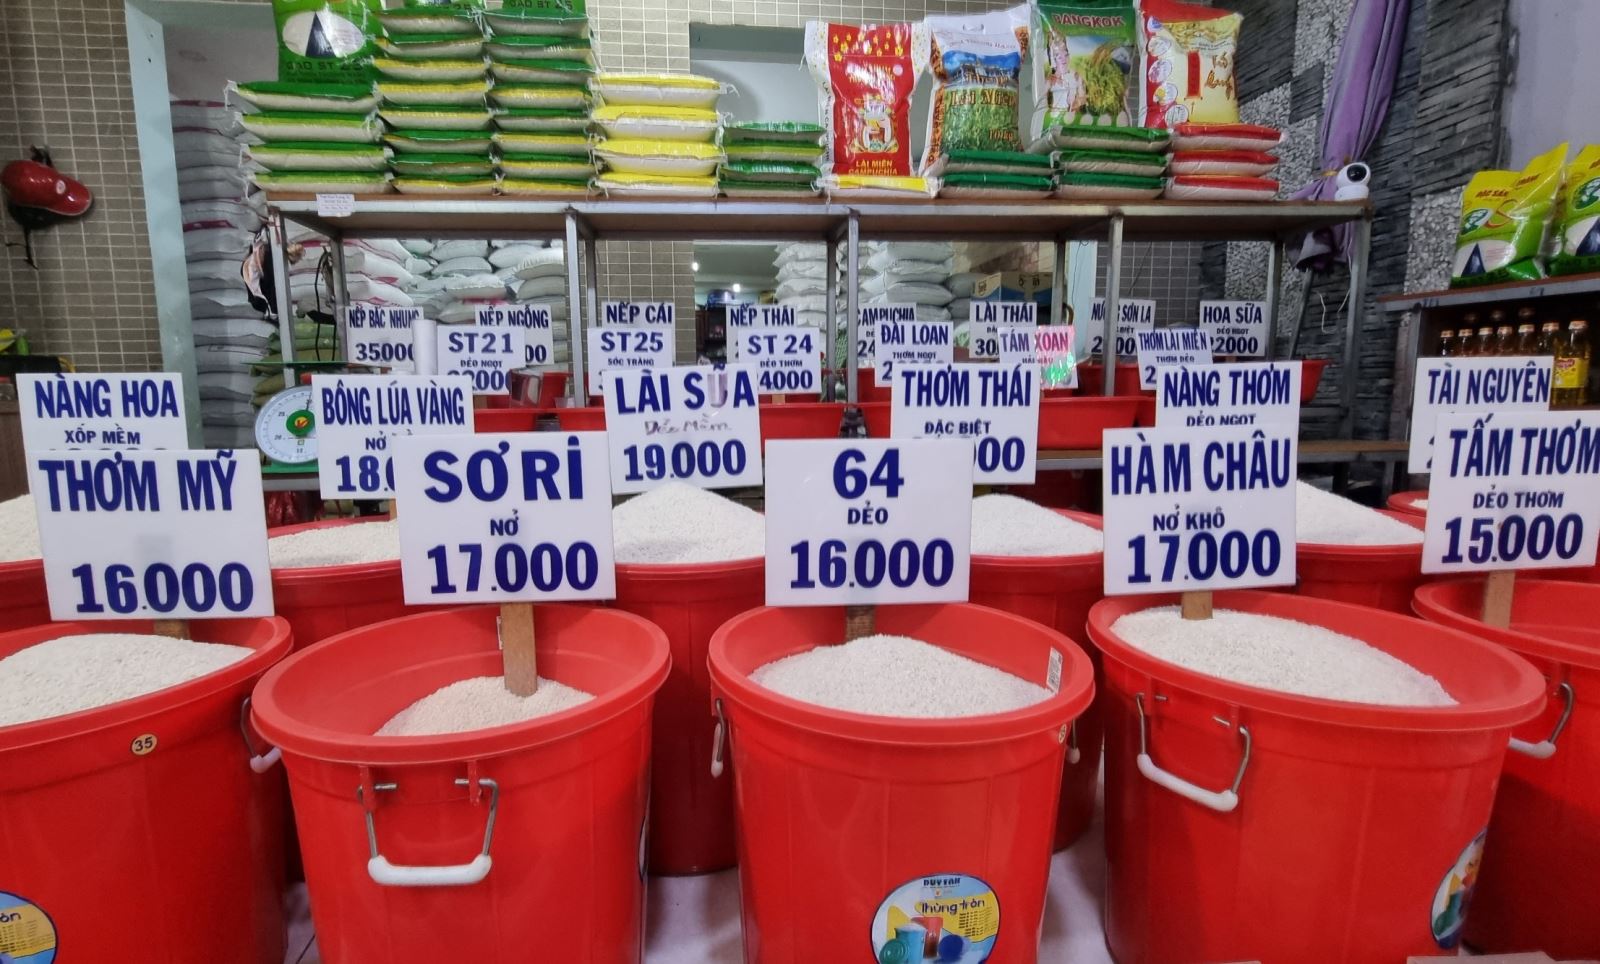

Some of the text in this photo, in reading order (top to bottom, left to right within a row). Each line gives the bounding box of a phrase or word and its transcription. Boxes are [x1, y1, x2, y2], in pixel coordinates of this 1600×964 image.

[606, 301, 672, 325] NẾP CÁI
[730, 303, 757, 326] NẾP
[881, 321, 905, 345] ĐÀI
[912, 324, 949, 345] LOAN
[975, 301, 1033, 323] LÀI THÁI
[1203, 302, 1263, 324] HOA SỮA
[1033, 331, 1070, 352] XOAN
[34, 373, 179, 419] NÀNG HOA
[321, 379, 465, 425] BÔNG LÚA VÀNG
[615, 369, 671, 415] LÀI
[901, 364, 970, 407] THƠM
[978, 363, 1031, 407] THÁI
[1163, 366, 1220, 409] NÀNG
[1229, 363, 1291, 406] THƠM
[1428, 362, 1461, 405] TÀI
[1465, 361, 1551, 405] NGUYÊN
[64, 423, 141, 445] XỐP MỀM
[365, 431, 387, 450] NỞ
[924, 418, 991, 438] ĐẶC BIỆT
[1186, 410, 1215, 427] DẺO
[623, 438, 747, 482] 19.000
[1110, 430, 1292, 496] HÀM CHÂU
[1449, 413, 1514, 478] TẤM
[1519, 418, 1600, 476] THƠM
[38, 449, 237, 512] THƠM MỸ
[423, 441, 510, 503] SƠ
[832, 448, 905, 500] 64
[846, 500, 889, 525] DẺO
[1153, 504, 1226, 531] NỞ KHÔ
[1472, 484, 1565, 509] DẺO THƠM
[490, 509, 519, 537] NỞ
[1441, 513, 1584, 564] 15.000
[427, 541, 599, 595] 17.000
[789, 538, 954, 589] 16.000
[1127, 528, 1282, 584] 17.000
[72, 561, 254, 614] 16.000
[135, 736, 153, 752] 35
